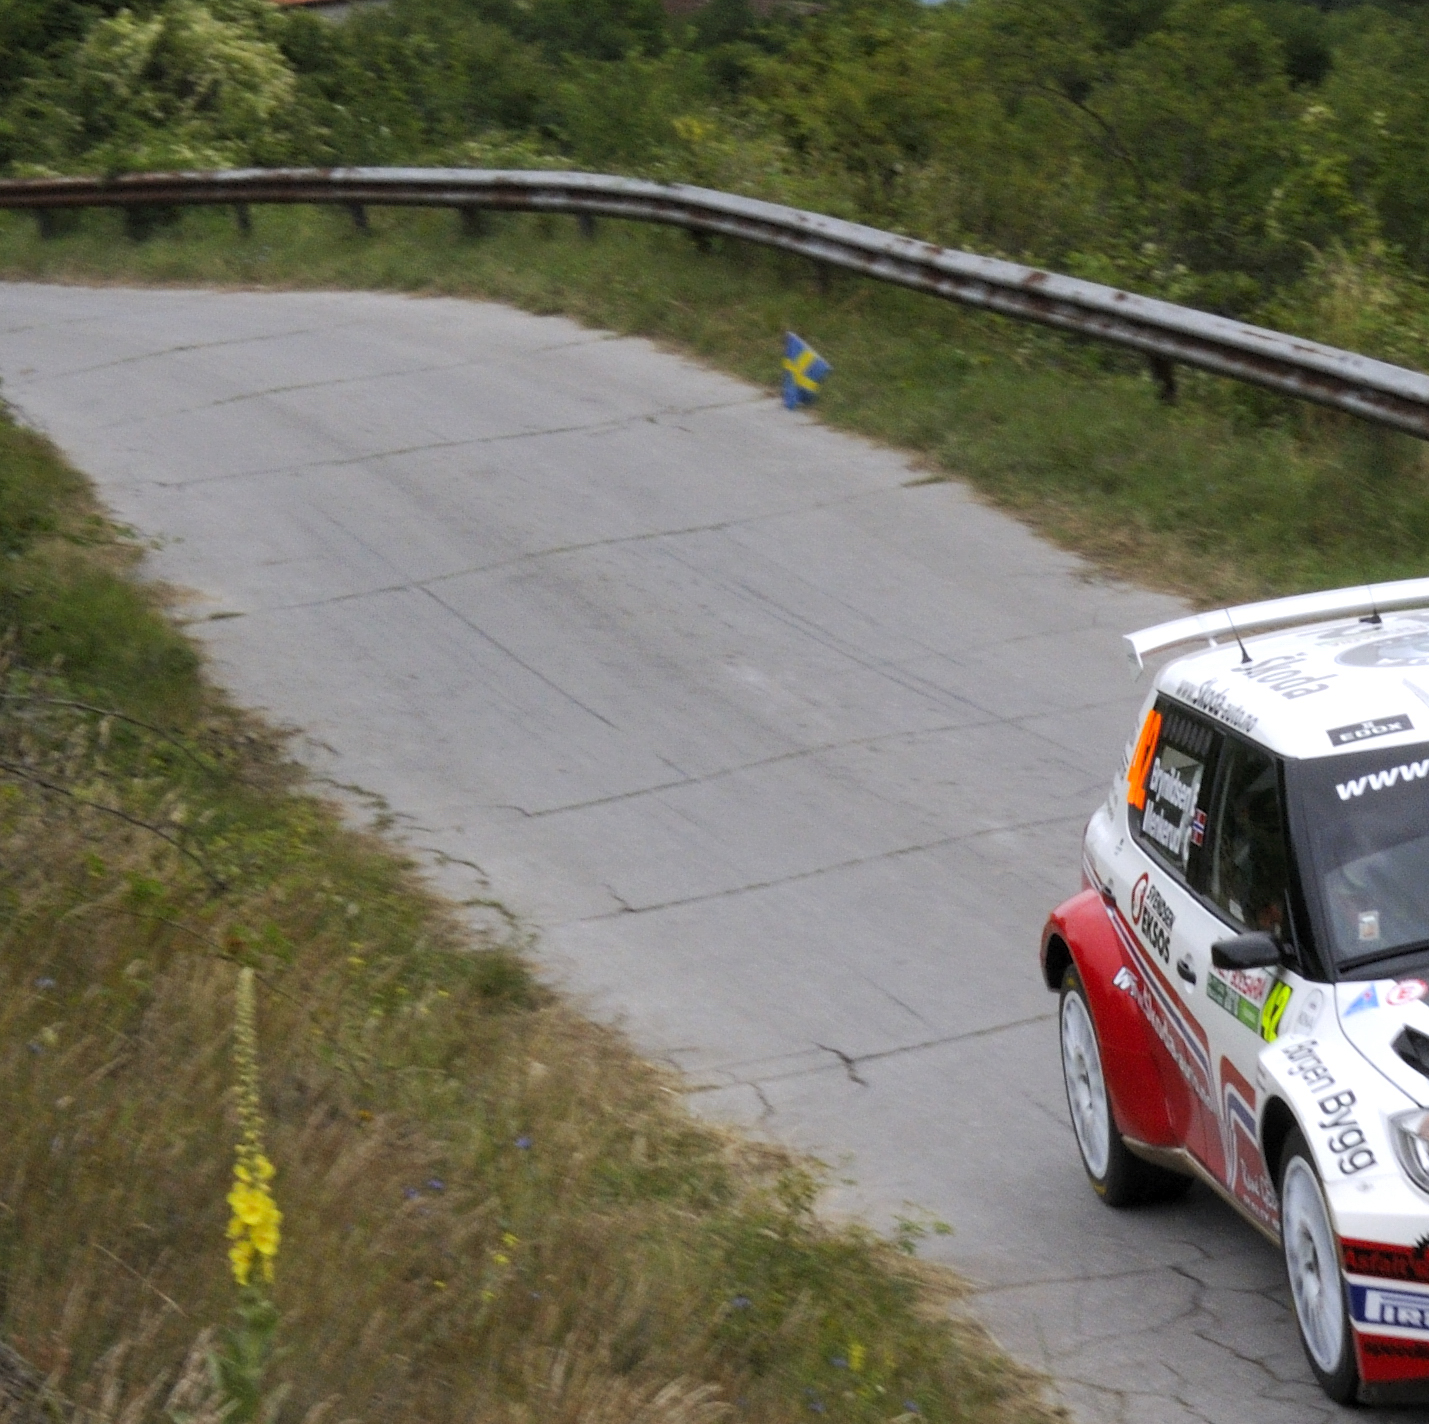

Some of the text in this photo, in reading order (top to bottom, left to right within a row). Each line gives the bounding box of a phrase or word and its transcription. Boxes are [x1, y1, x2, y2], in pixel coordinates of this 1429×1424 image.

[1339, 721, 1403, 742] EDOX
[1141, 906, 1171, 964] EKSOS
[1316, 1087, 1379, 1176] Bygg
